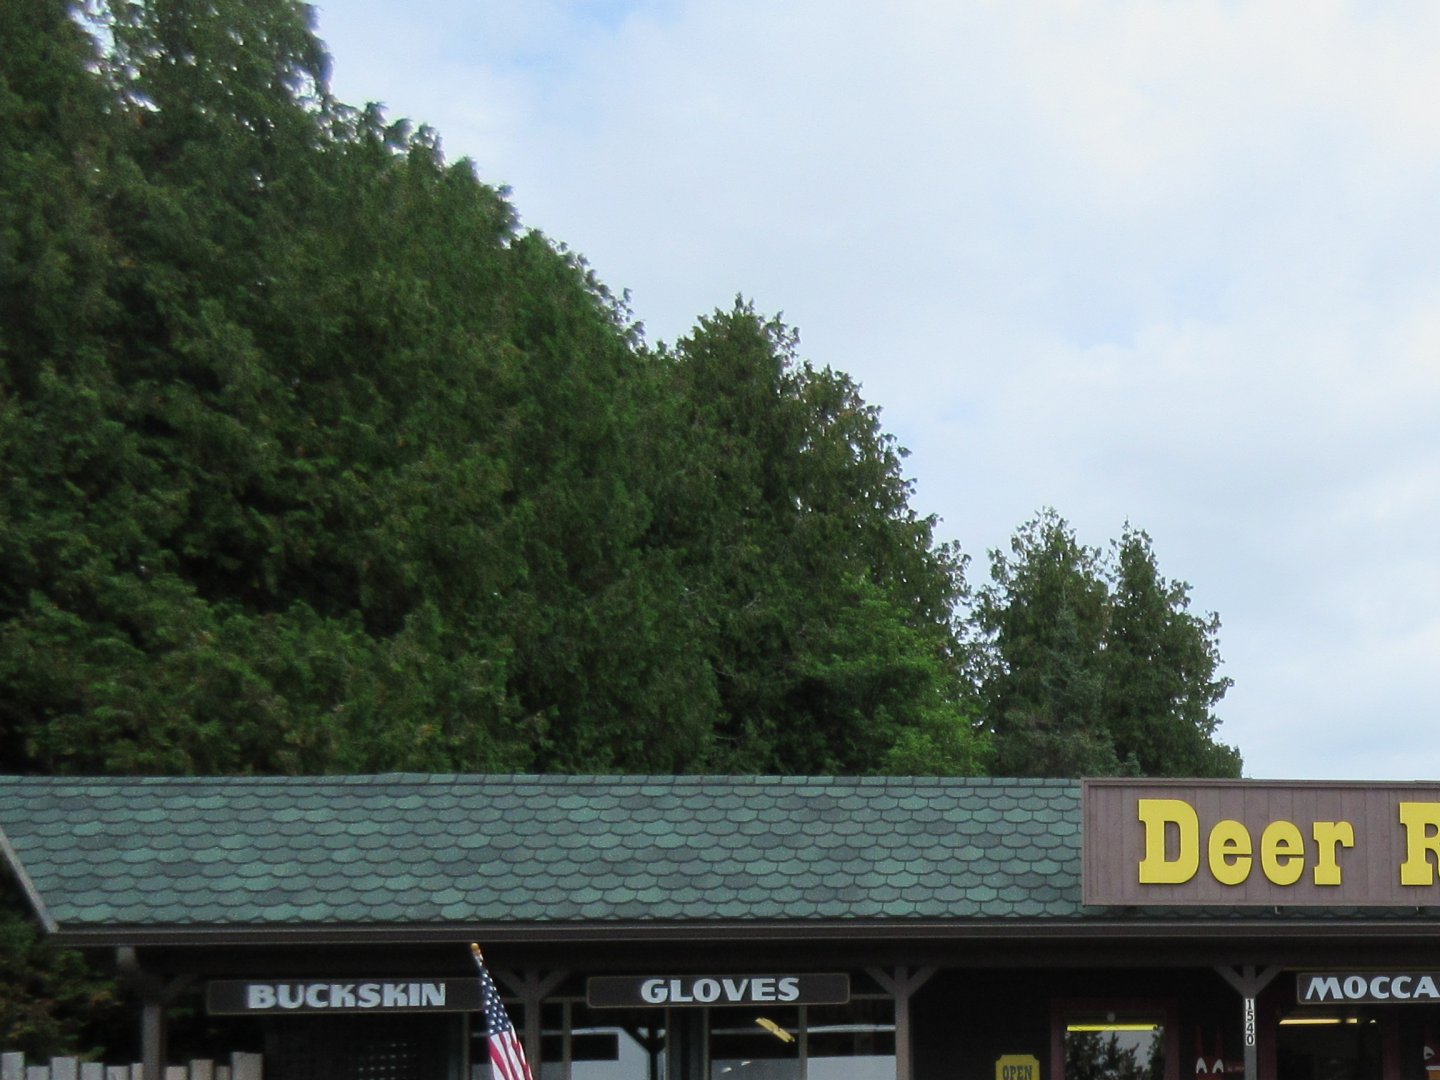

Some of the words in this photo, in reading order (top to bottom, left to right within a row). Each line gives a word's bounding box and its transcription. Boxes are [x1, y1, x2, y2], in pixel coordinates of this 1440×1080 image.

[1138, 798, 1355, 886] Deer
[248, 982, 447, 1009] BUCKSKIN
[640, 977, 801, 1003] GLOVES
[1245, 998, 1255, 1046] 1540
